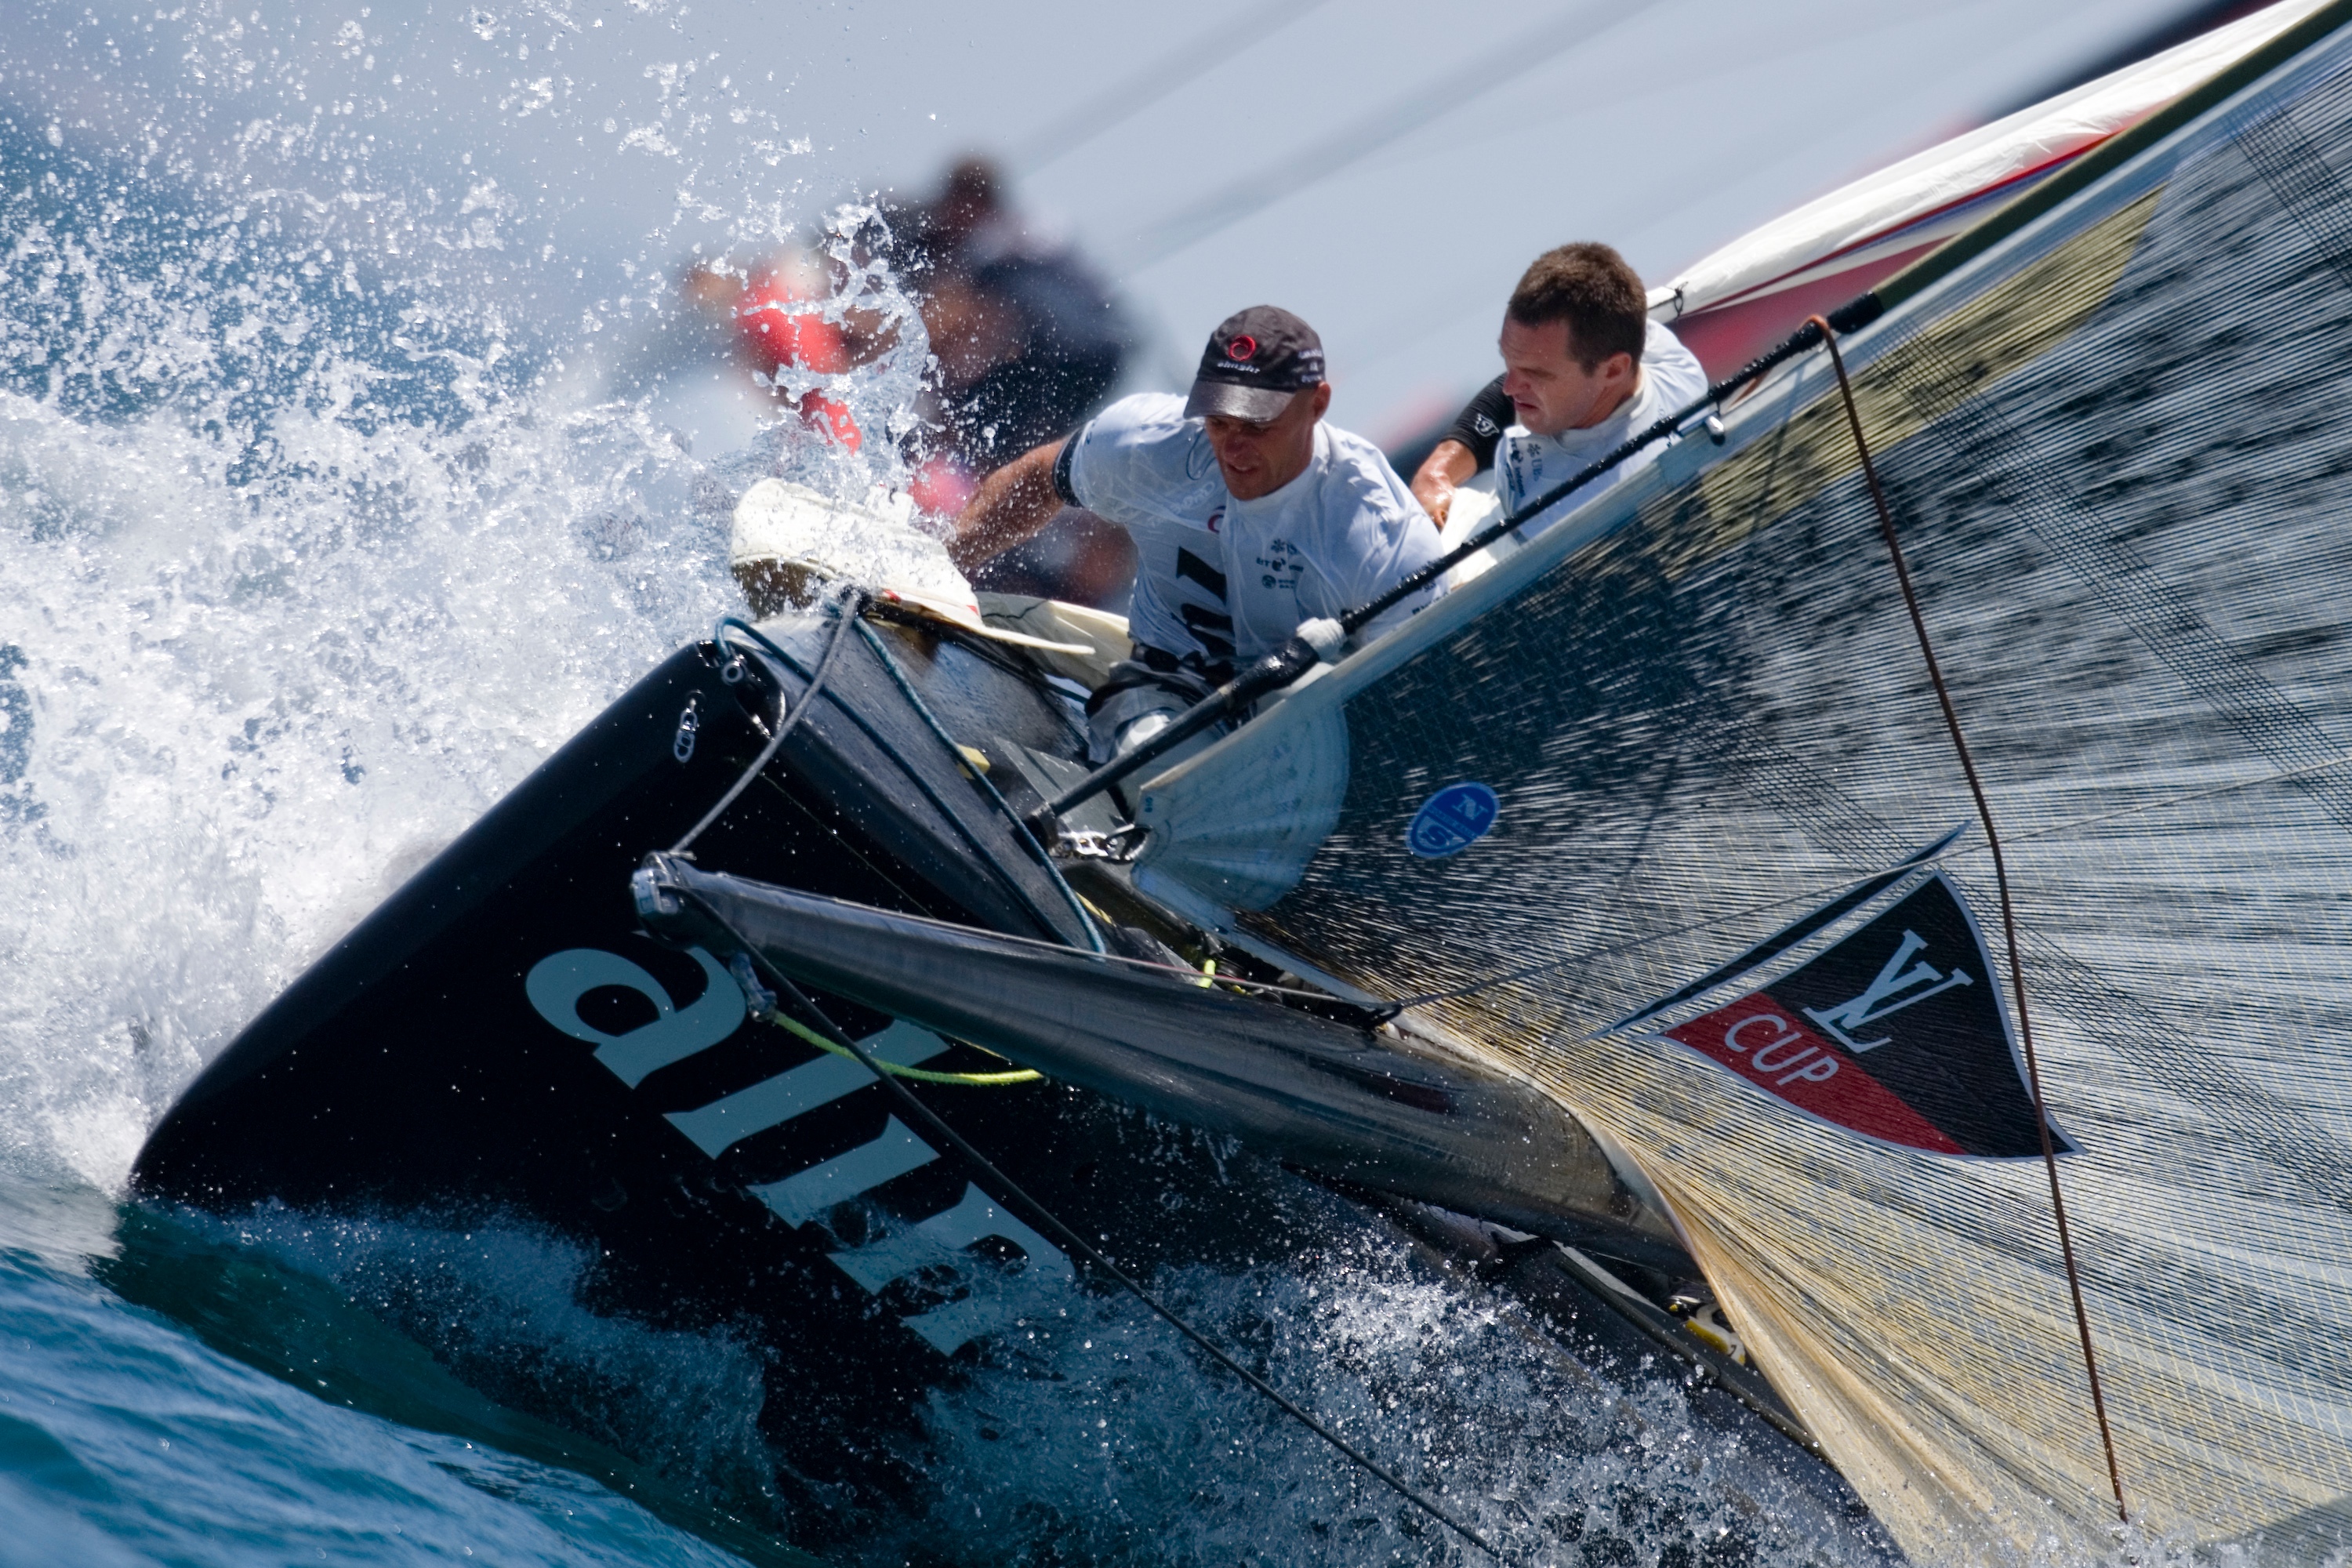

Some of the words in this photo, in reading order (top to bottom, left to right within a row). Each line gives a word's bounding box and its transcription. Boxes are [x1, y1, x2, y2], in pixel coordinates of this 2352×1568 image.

[1451, 793, 1490, 821] N
[1419, 824, 1454, 847] S
[1723, 1013, 1840, 1087] CUP
